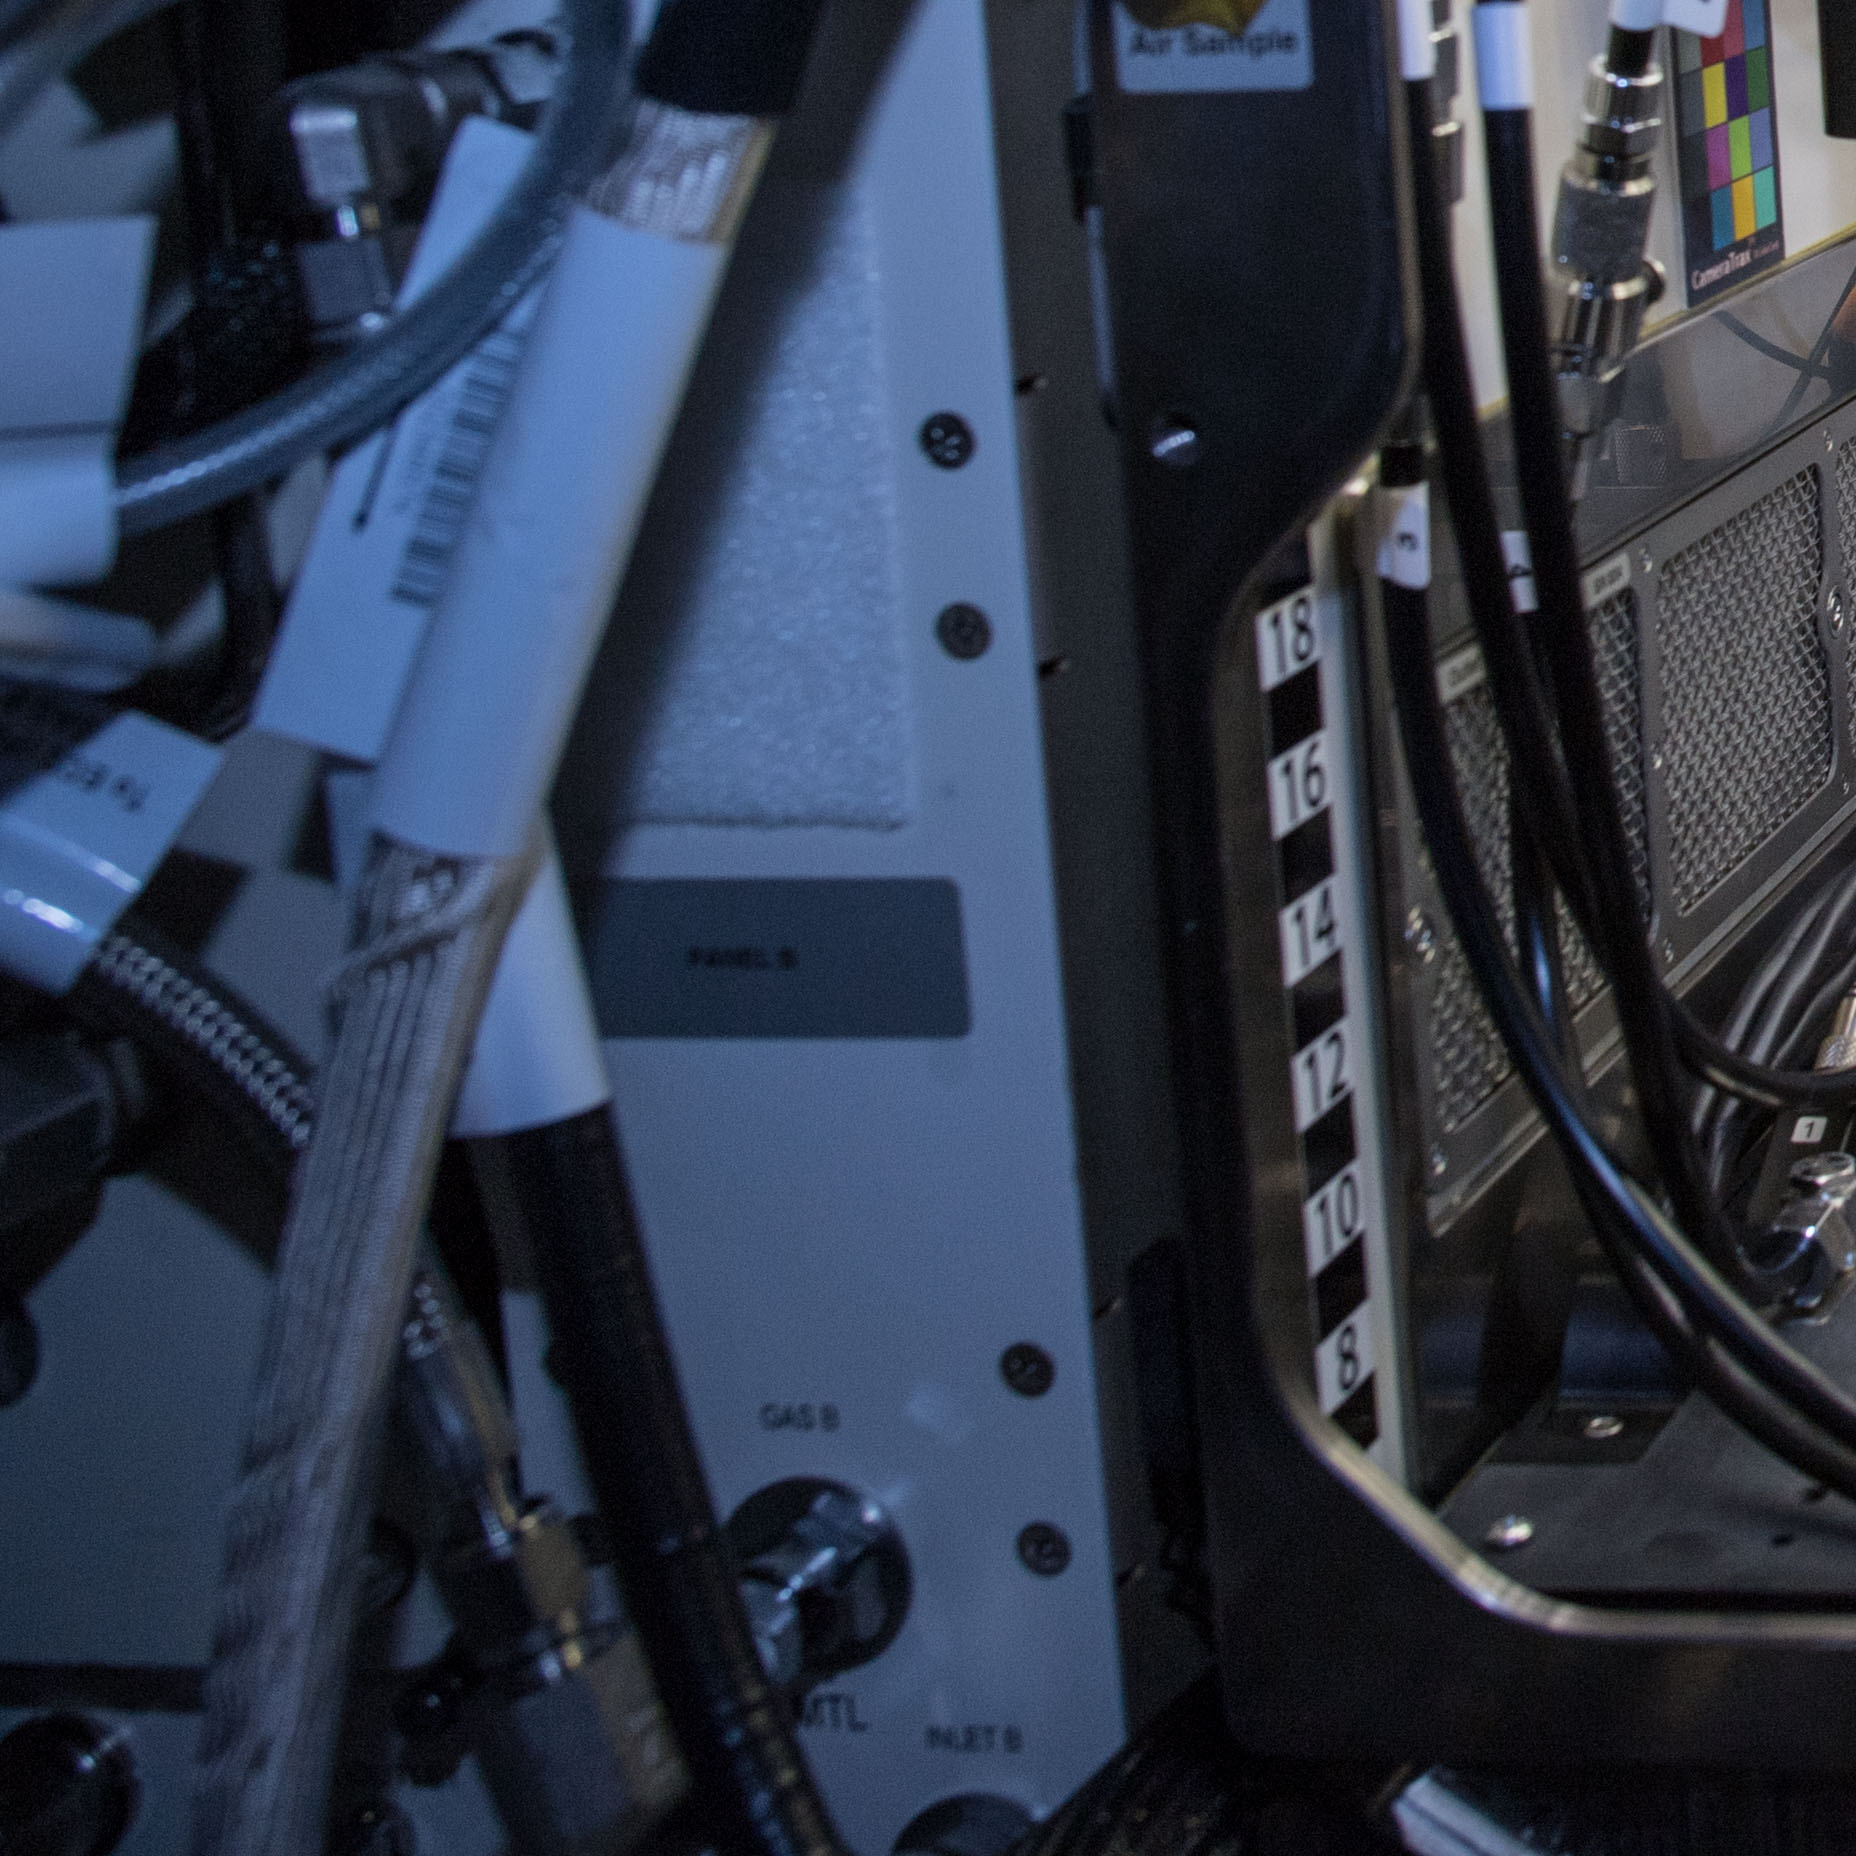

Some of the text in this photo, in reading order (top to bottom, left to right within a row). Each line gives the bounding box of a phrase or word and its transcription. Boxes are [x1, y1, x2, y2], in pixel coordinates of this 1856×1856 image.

[1270, 594, 1312, 681] 18
[1281, 740, 1326, 828] 16
[1296, 888, 1337, 968] 14
[1306, 1031, 1348, 1116] 12
[1806, 1121, 1815, 1139] 1
[1314, 1172, 1359, 1258] 10
[1339, 1324, 1360, 1393] 8
